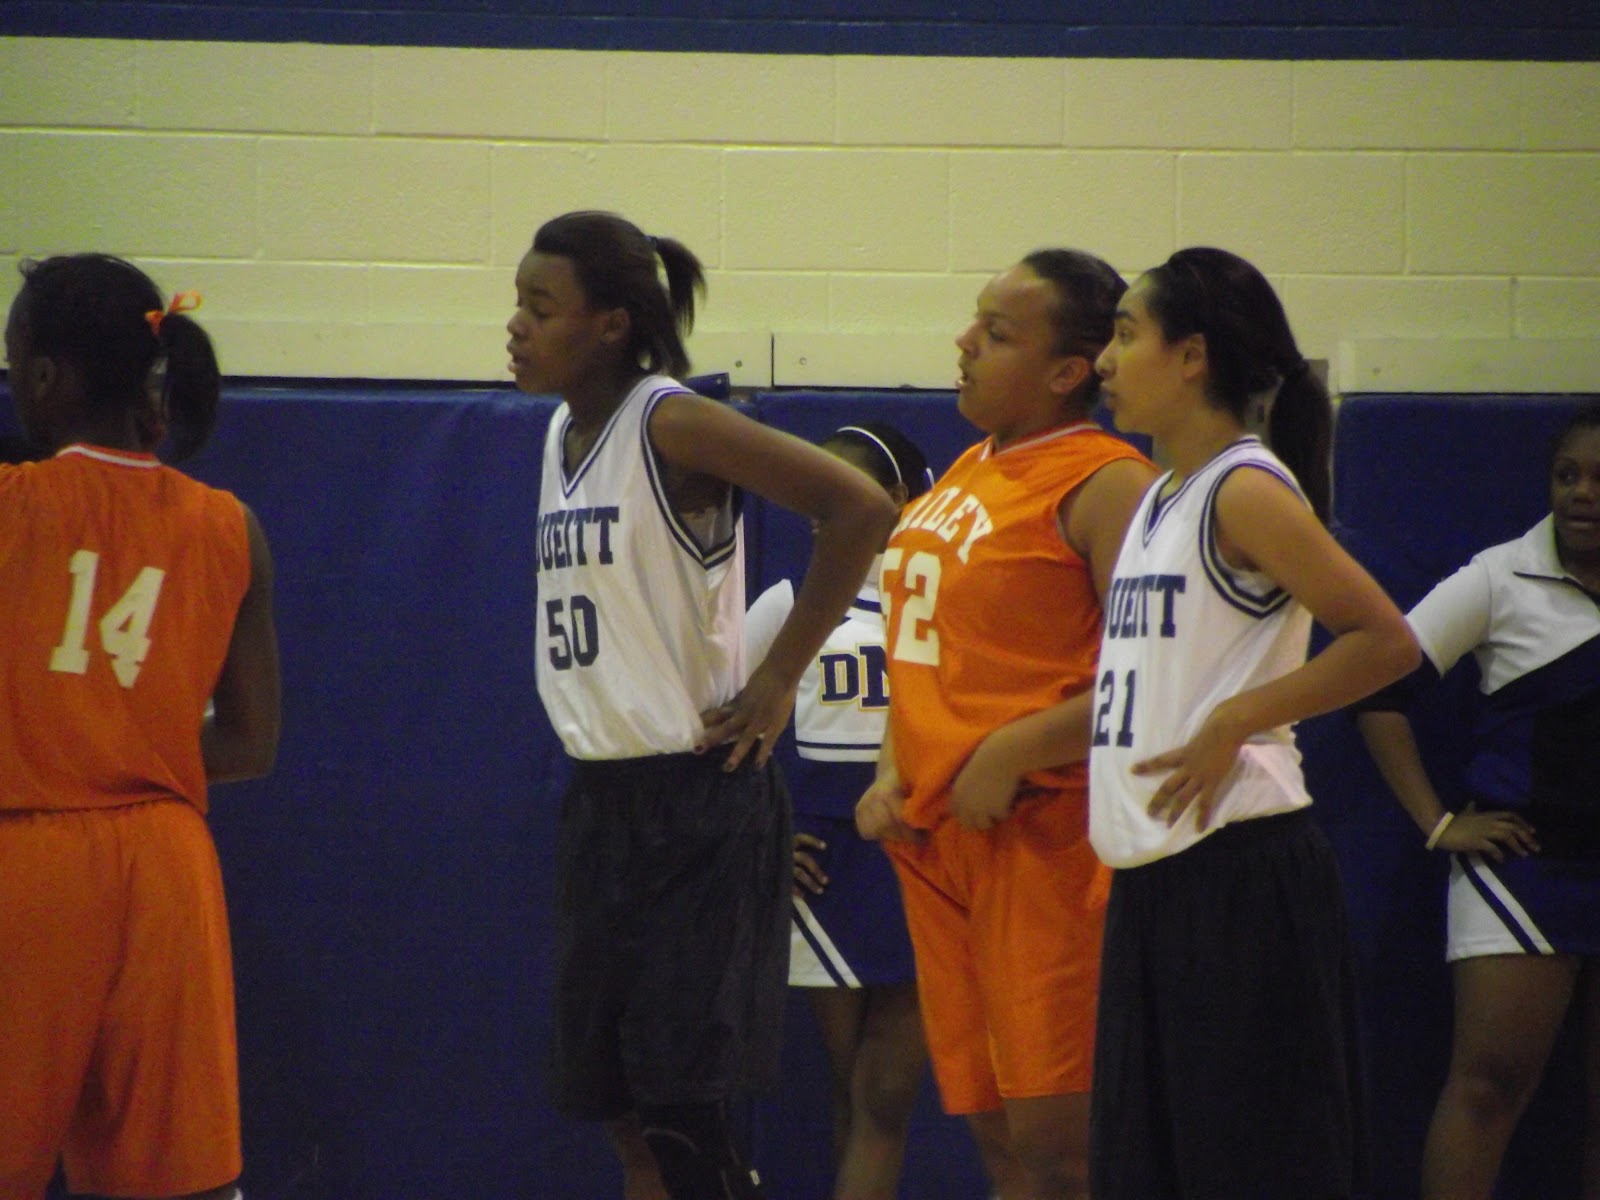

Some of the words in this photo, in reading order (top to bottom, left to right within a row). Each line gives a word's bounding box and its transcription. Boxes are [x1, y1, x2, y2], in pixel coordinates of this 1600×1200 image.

[48, 549, 166, 689] 14
[546, 595, 599, 670] 50
[1093, 669, 1136, 748] 21
